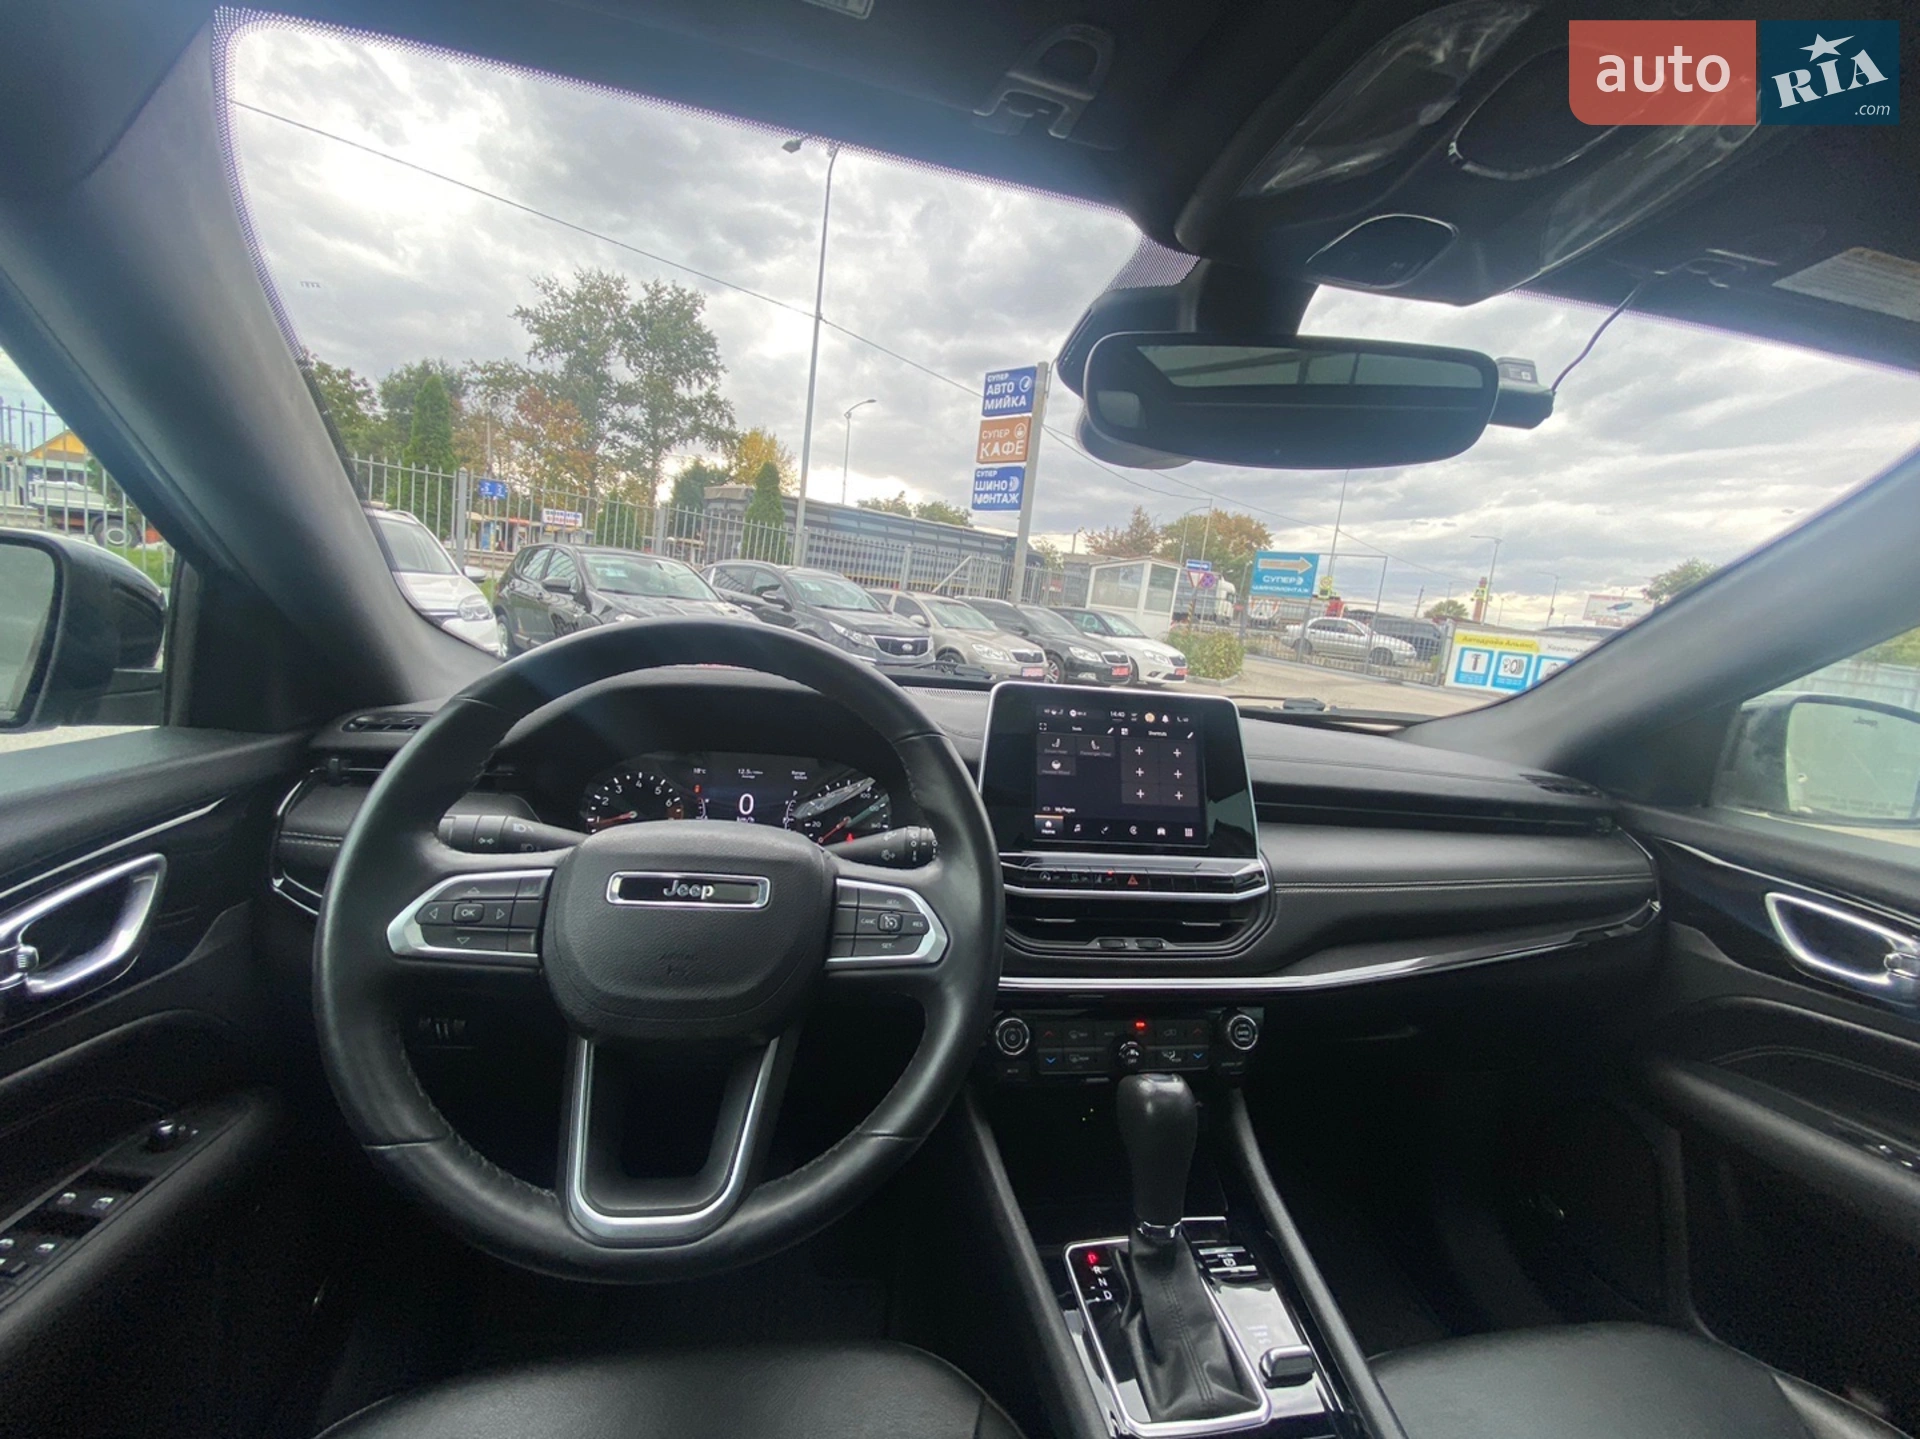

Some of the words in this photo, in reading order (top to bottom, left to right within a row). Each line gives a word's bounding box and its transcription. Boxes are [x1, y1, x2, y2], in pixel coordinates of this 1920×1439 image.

[986, 382, 1015, 396] АВТО
[984, 394, 1027, 411] МИЙКА
[981, 429, 1010, 440] СУПЕР
[979, 440, 1025, 460] КАФЕ
[974, 480, 1008, 492] ШИНО
[973, 492, 1020, 505] МОНТАЖ
[1262, 575, 1296, 584] СУПЕР
[738, 793, 755, 816] 0
[663, 879, 715, 900] Jeep
[460, 908, 476, 917] OK
[1088, 1254, 1097, 1264] P
[1093, 1265, 1102, 1275] R
[1098, 1277, 1108, 1287] N
[1103, 1290, 1113, 1300] D
